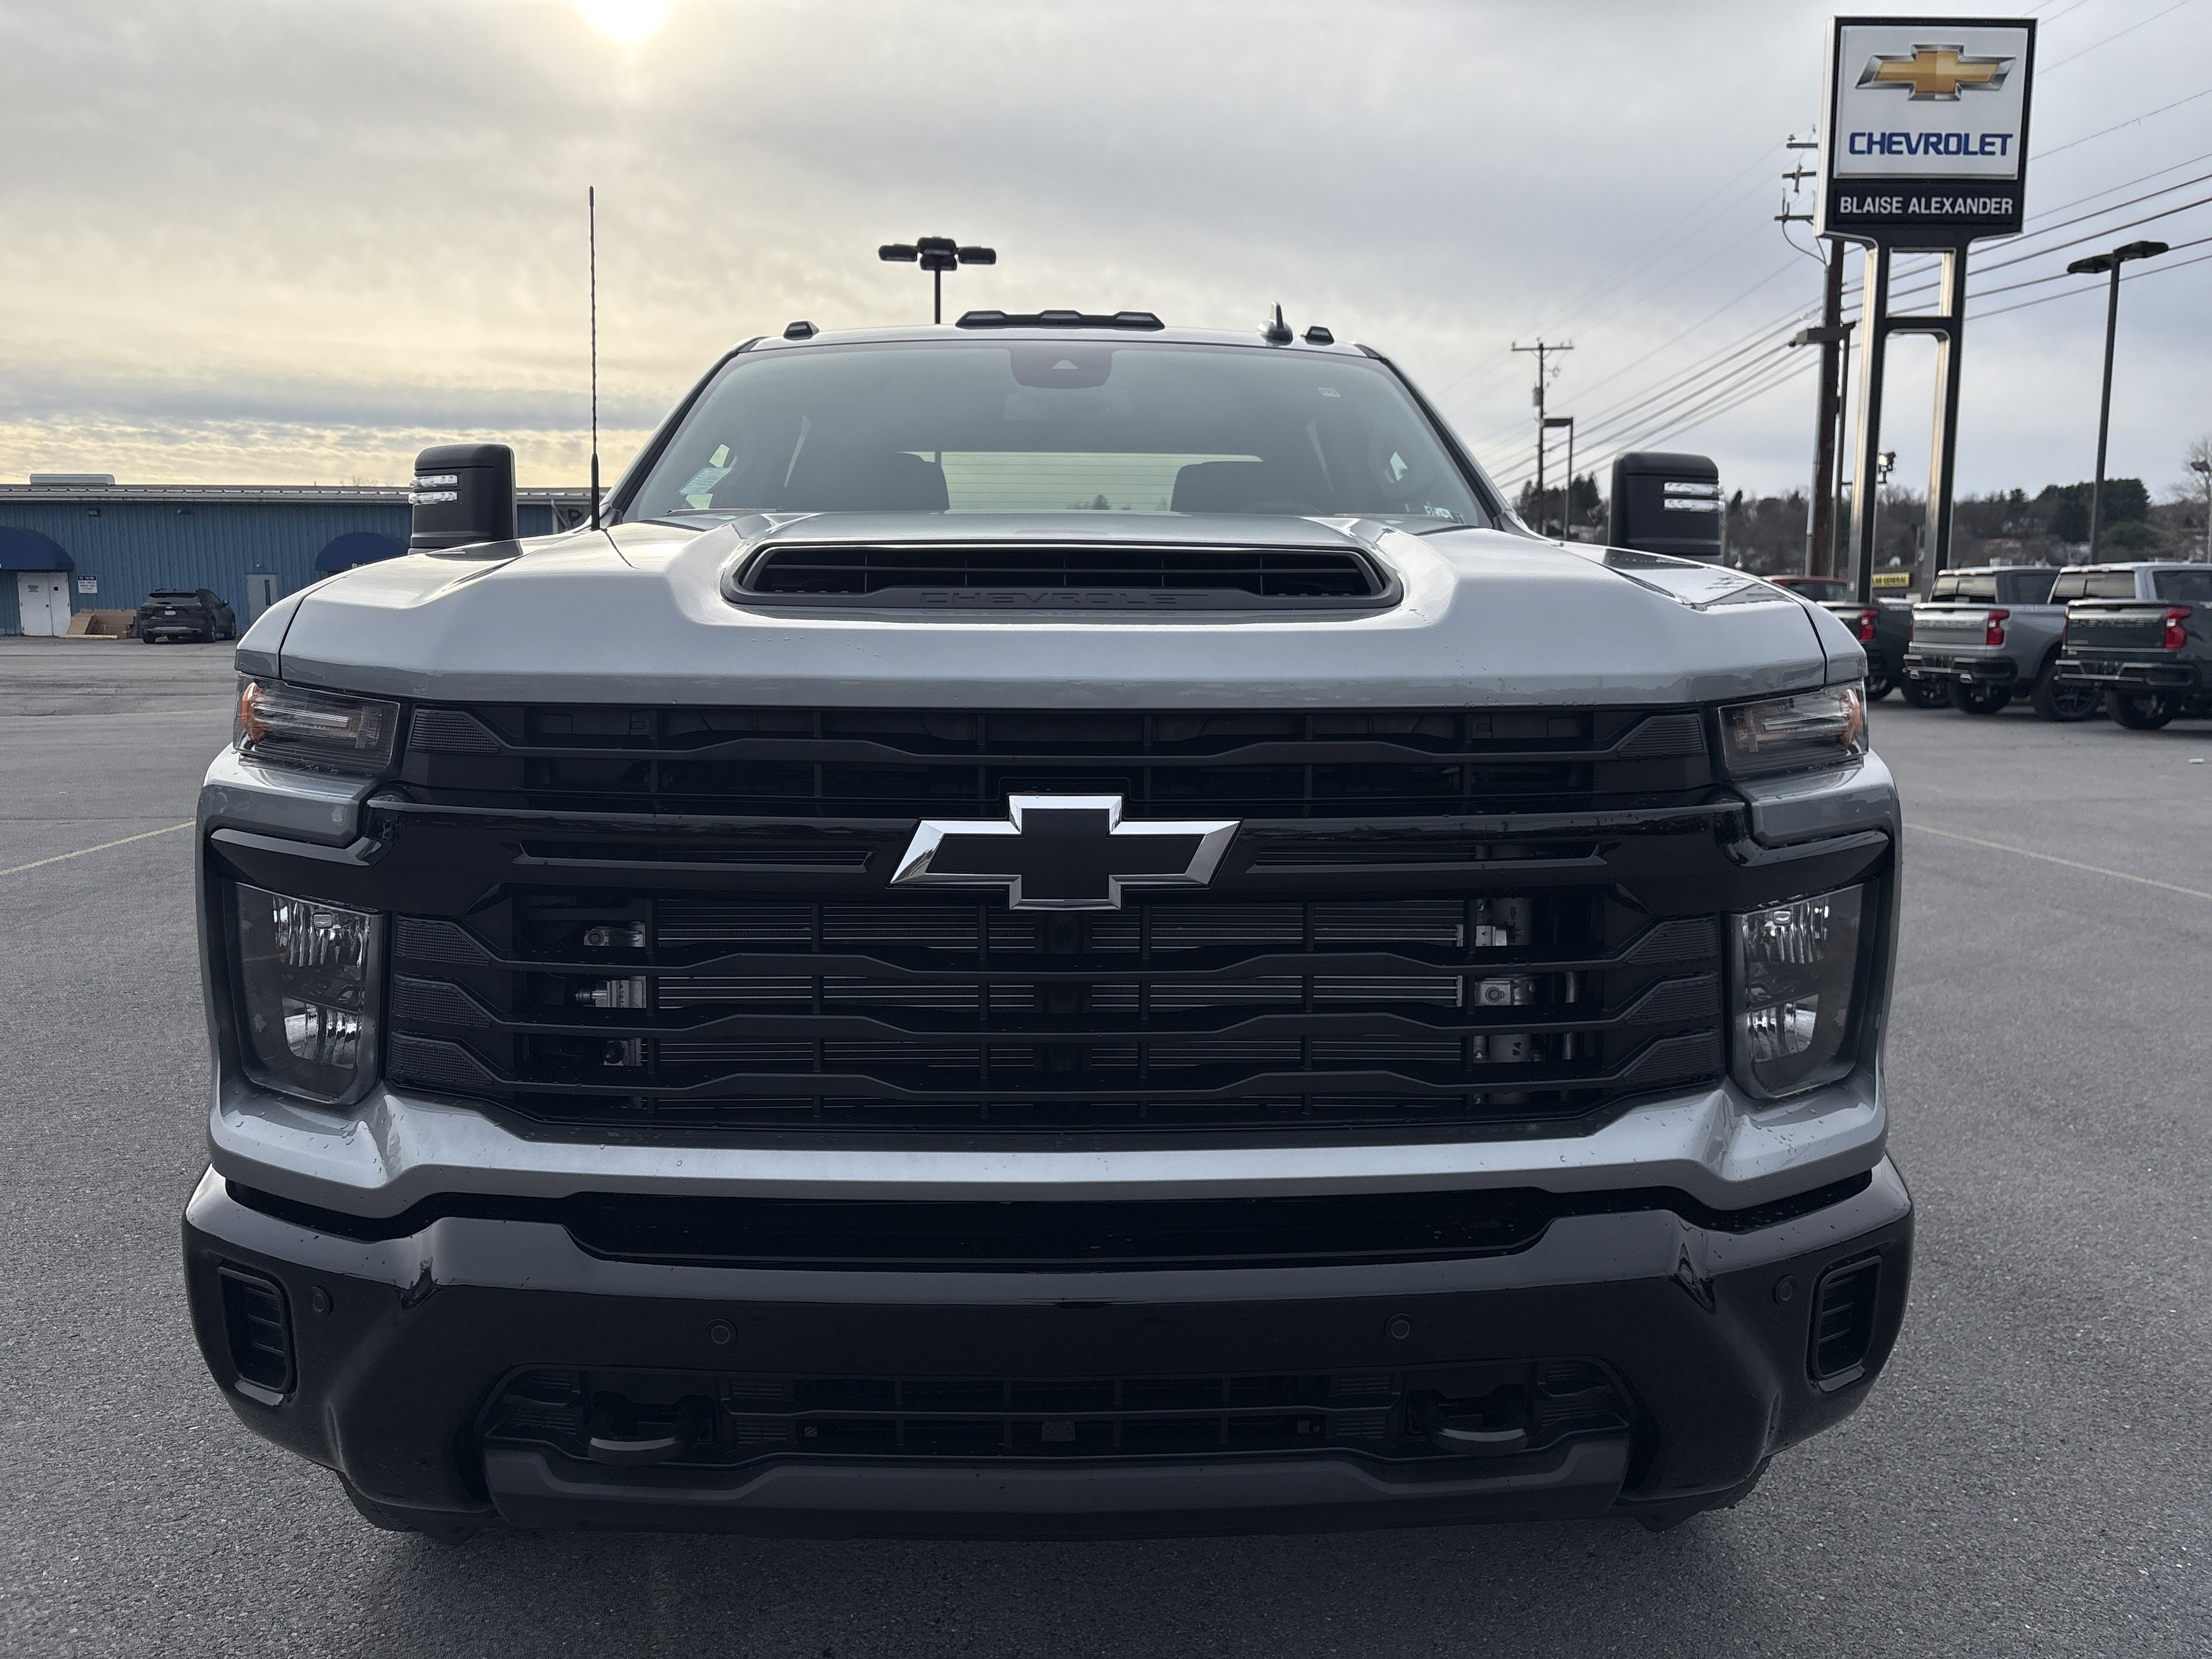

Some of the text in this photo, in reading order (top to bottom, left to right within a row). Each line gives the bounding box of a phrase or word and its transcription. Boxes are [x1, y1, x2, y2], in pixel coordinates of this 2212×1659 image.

[1849, 132, 2013, 155] CHEVROLET
[1840, 196, 2013, 215] BLAISE ALEXANDER
[921, 592, 1207, 605] CHEVROLET
